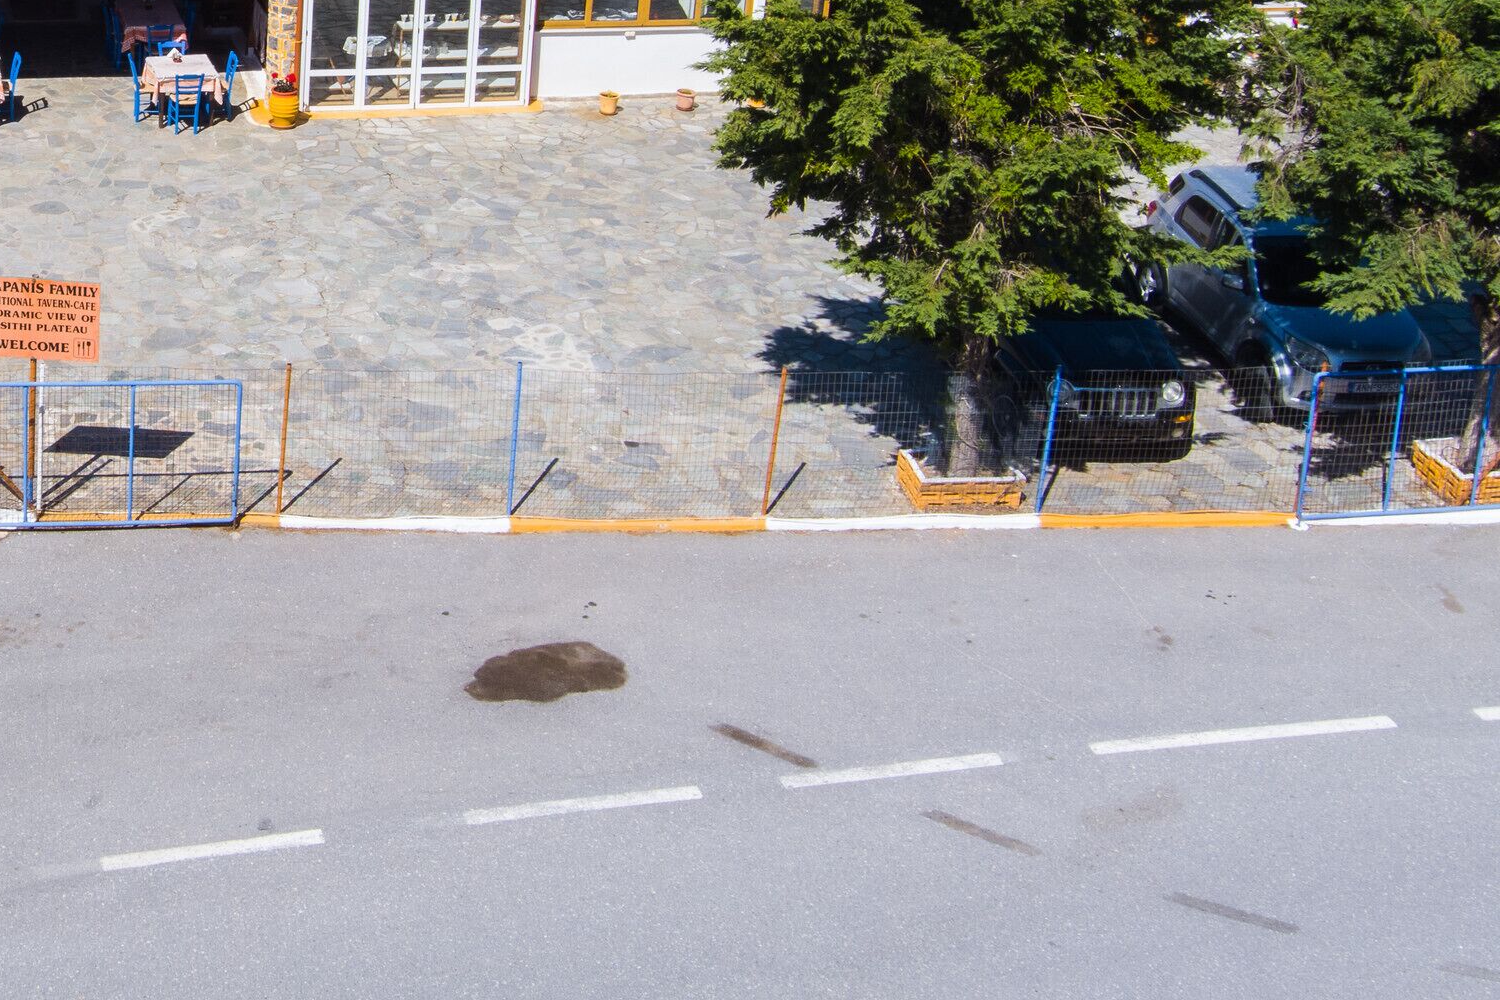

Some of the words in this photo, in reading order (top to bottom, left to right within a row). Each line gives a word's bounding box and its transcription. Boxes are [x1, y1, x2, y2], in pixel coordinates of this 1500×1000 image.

[49, 284, 98, 298] FAMILY
[47, 312, 77, 321] VIEW
[81, 315, 97, 323] OF
[36, 324, 88, 334] PLATEAU
